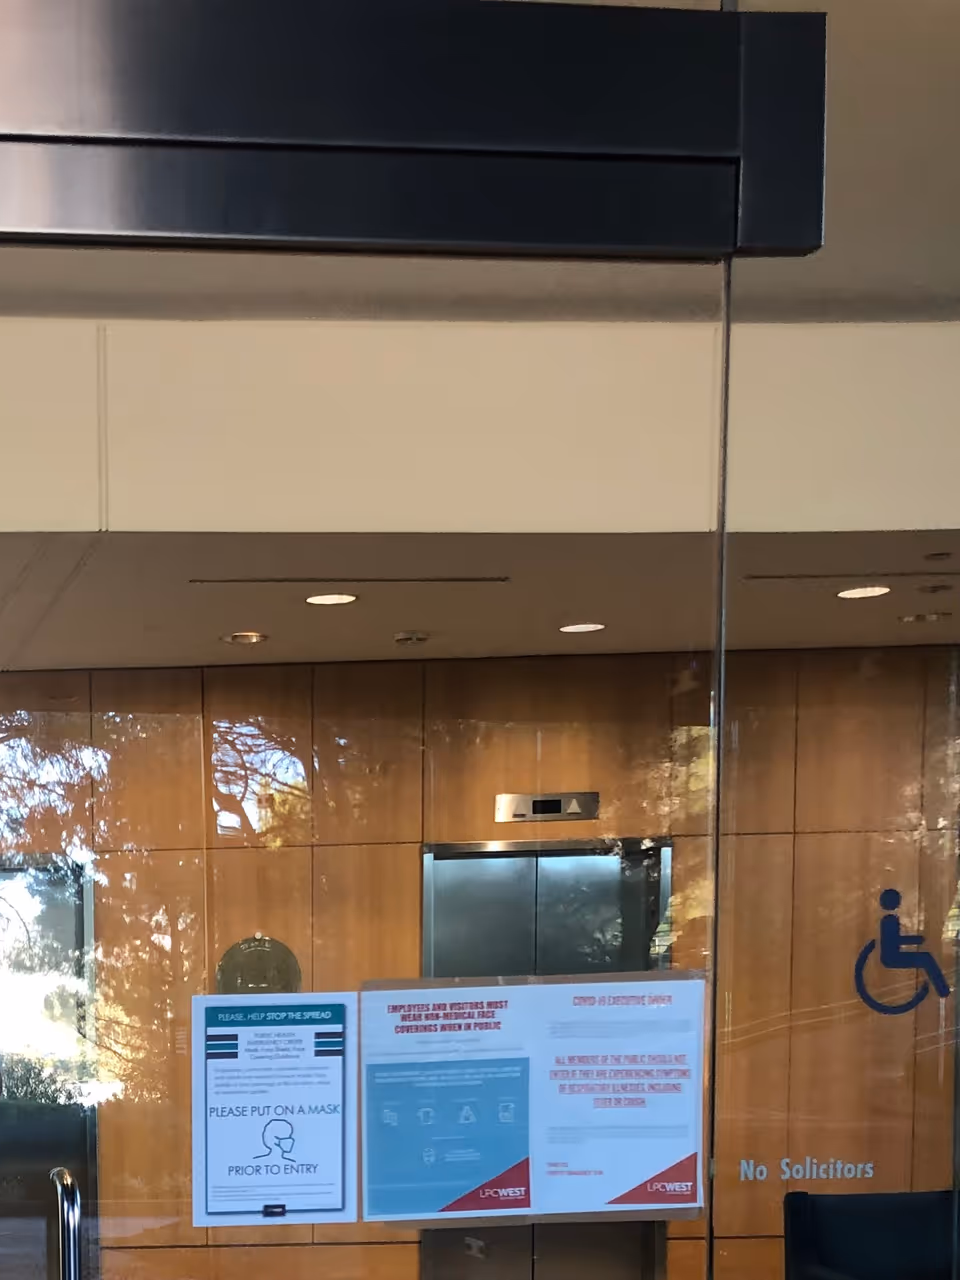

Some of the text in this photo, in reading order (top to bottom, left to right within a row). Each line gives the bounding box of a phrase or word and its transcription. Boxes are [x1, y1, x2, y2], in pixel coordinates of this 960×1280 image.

[387, 1000, 508, 1013] EMPLOYEES AND VISITORS MUST
[247, 1013, 266, 1021] HELP
[266, 1012, 287, 1020] STOP
[302, 1011, 332, 1019] SPREAD
[400, 1010, 495, 1022] WEAR NON-MEDICAL FACE
[394, 1021, 501, 1034] COVERINGS WHEN IN PUBLIC
[209, 1103, 340, 1118] PLEASE PUT ON A MASK
[228, 1163, 319, 1176] PRIOR TO ENTRY
[740, 1156, 874, 1181] No Solicitors
[480, 1187, 526, 1198] LPCWEST
[647, 1181, 693, 1192] LPCWEST
